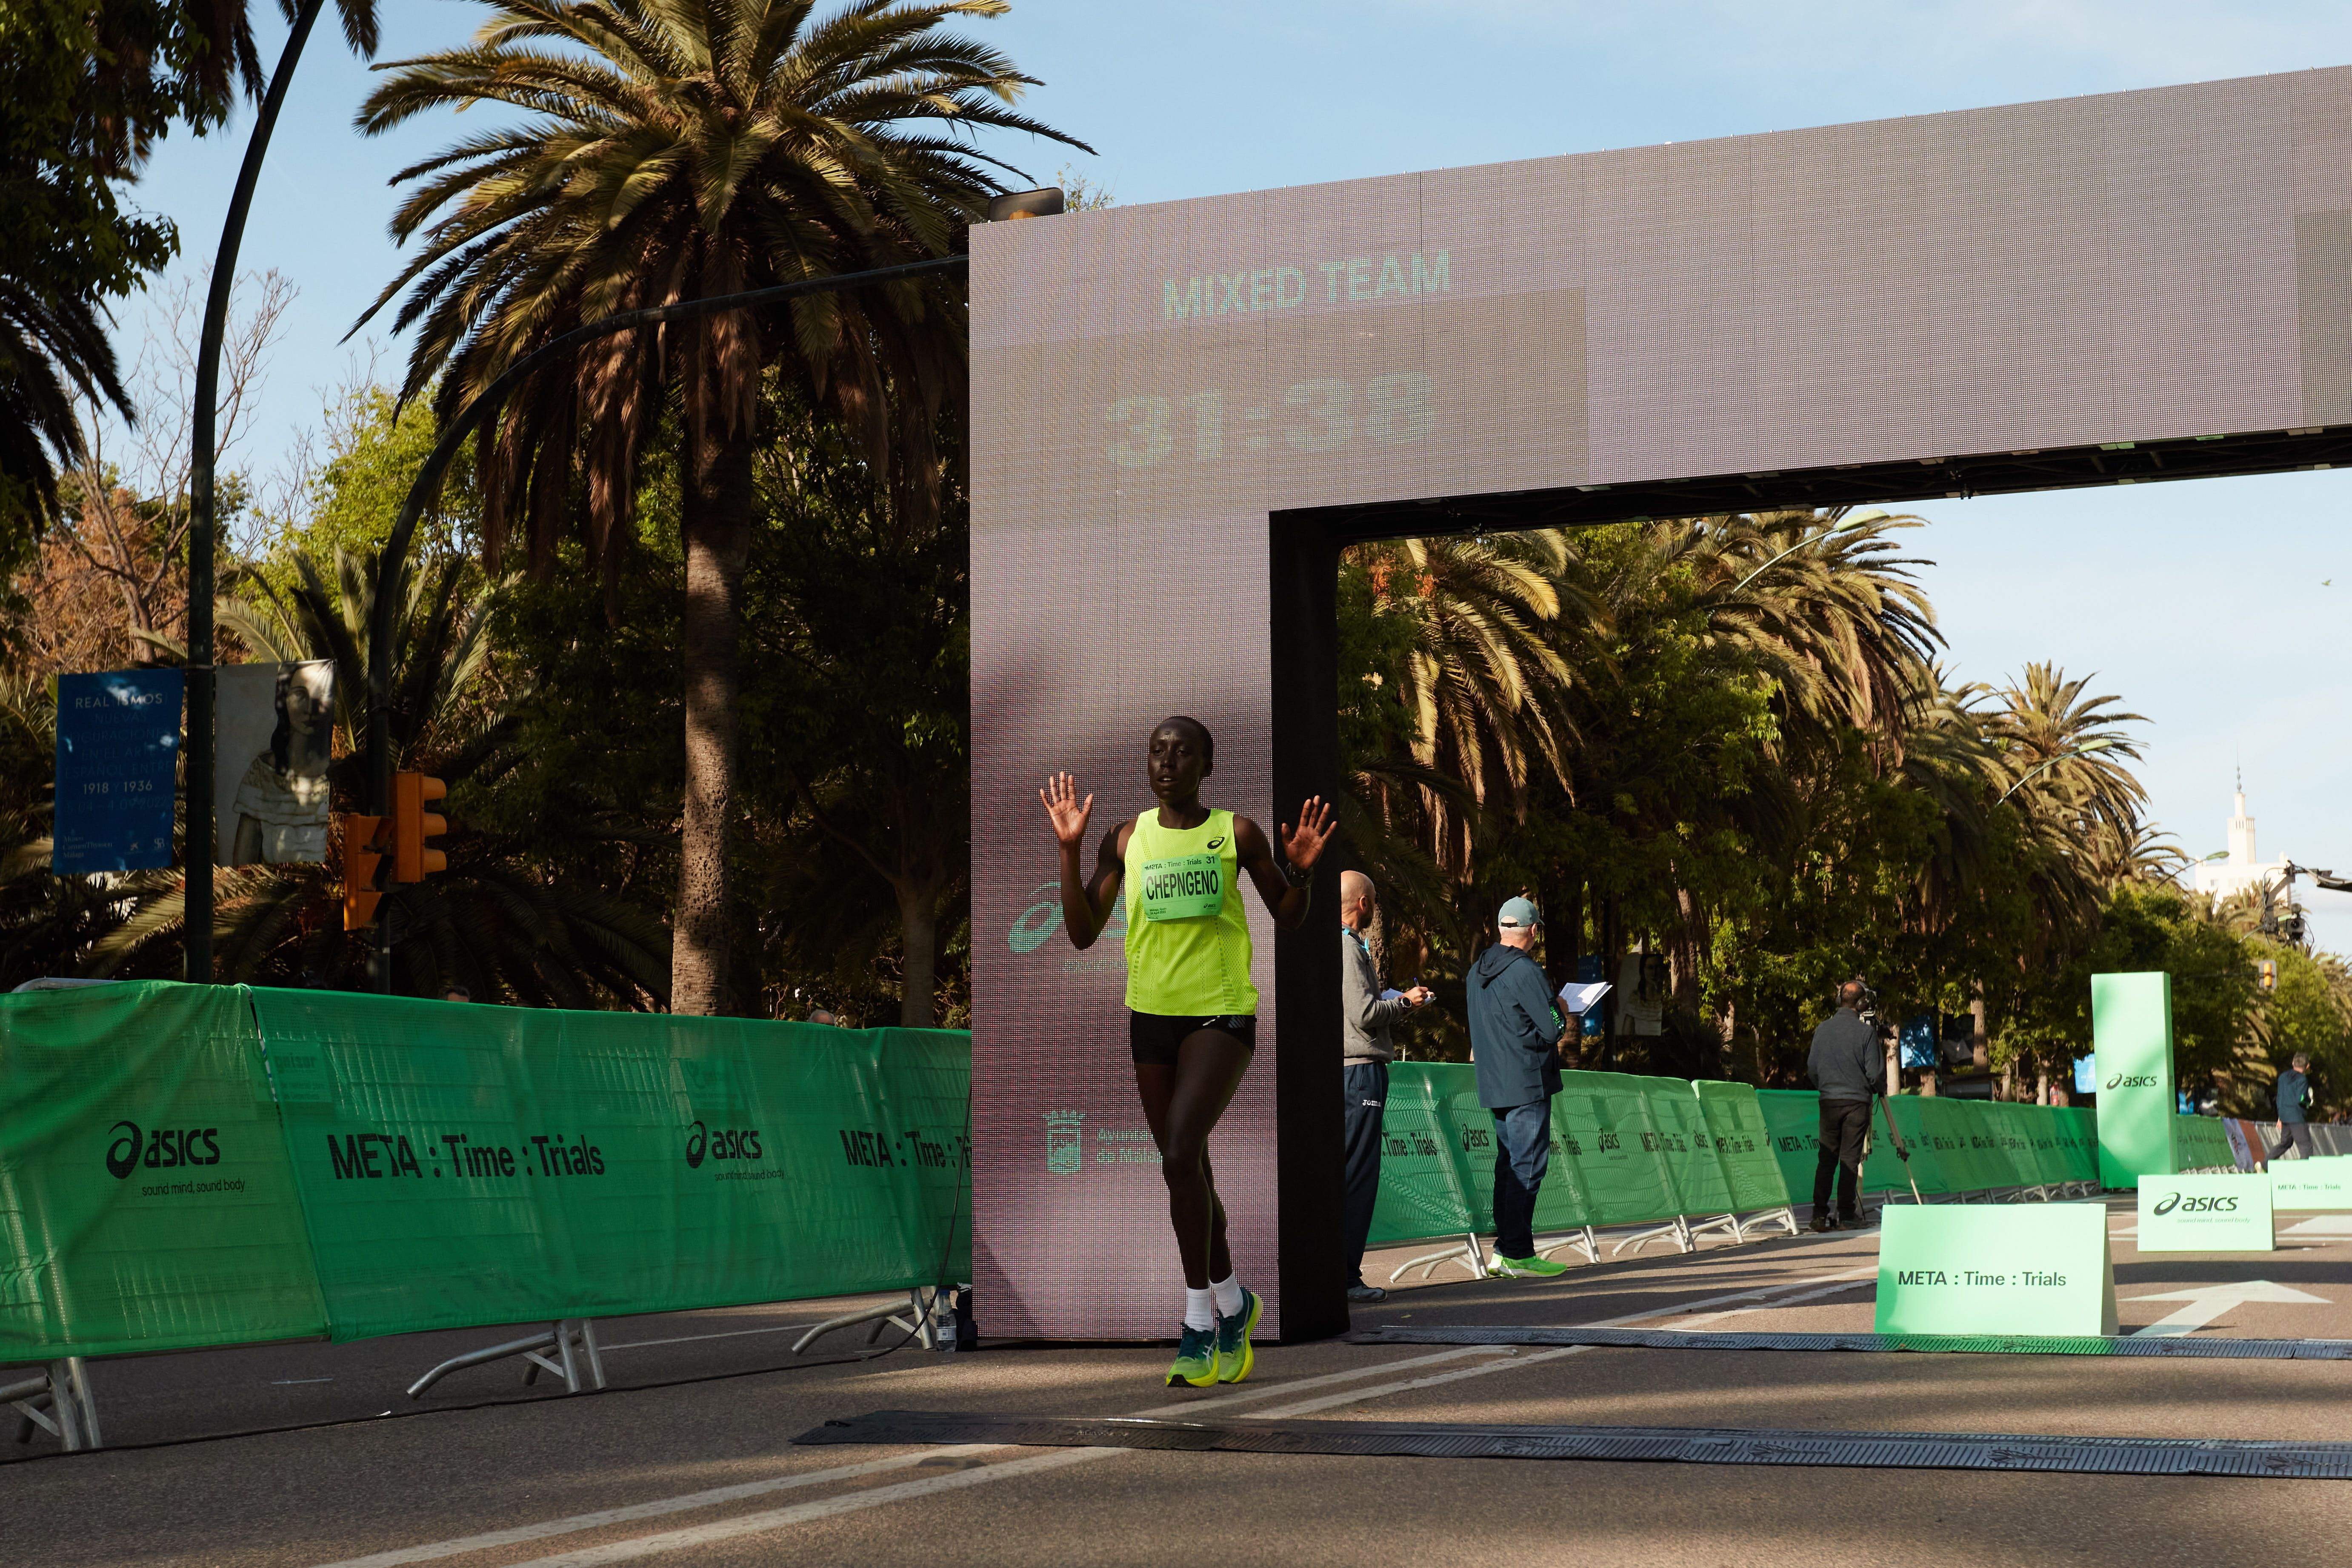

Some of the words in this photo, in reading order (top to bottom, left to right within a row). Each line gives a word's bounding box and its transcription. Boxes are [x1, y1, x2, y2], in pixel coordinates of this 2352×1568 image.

[1163, 266, 1306, 321] MIXED
[1320, 248, 1448, 304] TEAM
[75, 696, 109, 709] REAL
[83, 782, 109, 794] 1918
[123, 780, 152, 792] 1936
[1146, 870, 1218, 900] CHEPNGENO
[2123, 1076, 2157, 1087] asics
[712, 1130, 763, 1160] asics
[1382, 1131, 1408, 1157] Time
[1410, 1132, 1437, 1156] Trials
[1469, 1129, 1489, 1147] asics
[1778, 1136, 1803, 1153] META
[1805, 1135, 1820, 1149] Tim
[143, 1128, 220, 1168] asics
[327, 1134, 423, 1180] META
[441, 1133, 516, 1178] Time
[530, 1134, 606, 1177] Trials
[839, 1130, 895, 1168] META
[904, 1130, 946, 1168] Time
[766, 1168, 785, 1180] body
[142, 1182, 169, 1196] sound
[171, 1180, 195, 1195] mind,
[197, 1179, 222, 1193] sound
[223, 1178, 245, 1193] body
[2181, 1196, 2238, 1212] asics
[2235, 1217, 2251, 1225] body
[1898, 1271, 1947, 1285] META
[1964, 1271, 2005, 1285] Time
[2022, 1271, 2066, 1286] Trials
